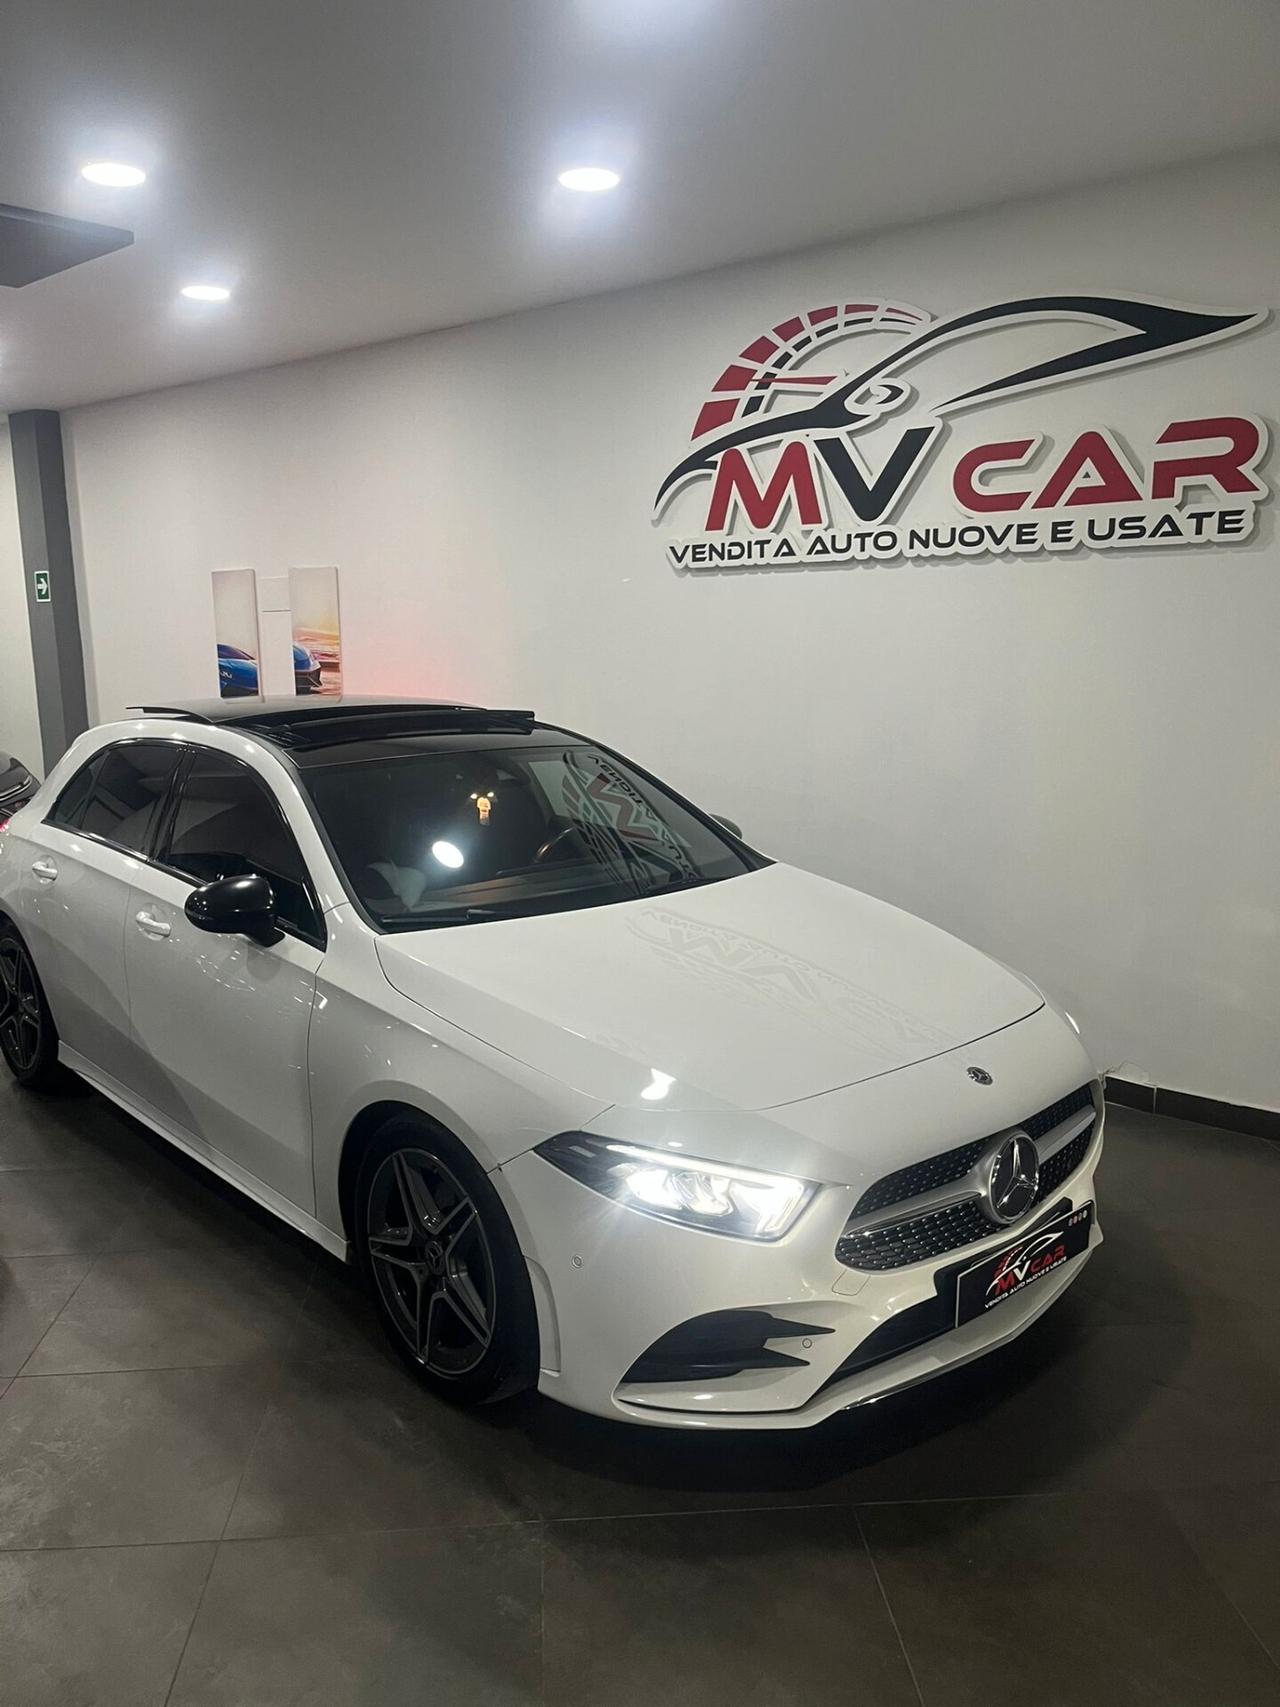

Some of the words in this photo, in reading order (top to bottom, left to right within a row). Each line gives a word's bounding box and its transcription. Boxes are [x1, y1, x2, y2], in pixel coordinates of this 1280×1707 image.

[704, 425, 935, 531] MV
[953, 416, 1261, 513] CAR
[669, 537, 797, 564] VENDITA
[806, 530, 898, 556] AUTO
[908, 523, 1039, 550] NUOVE
[1051, 520, 1075, 544] E
[1088, 509, 1247, 541] USATE
[994, 1260, 1032, 1296] MV
[1031, 1245, 1065, 1273] CAR
